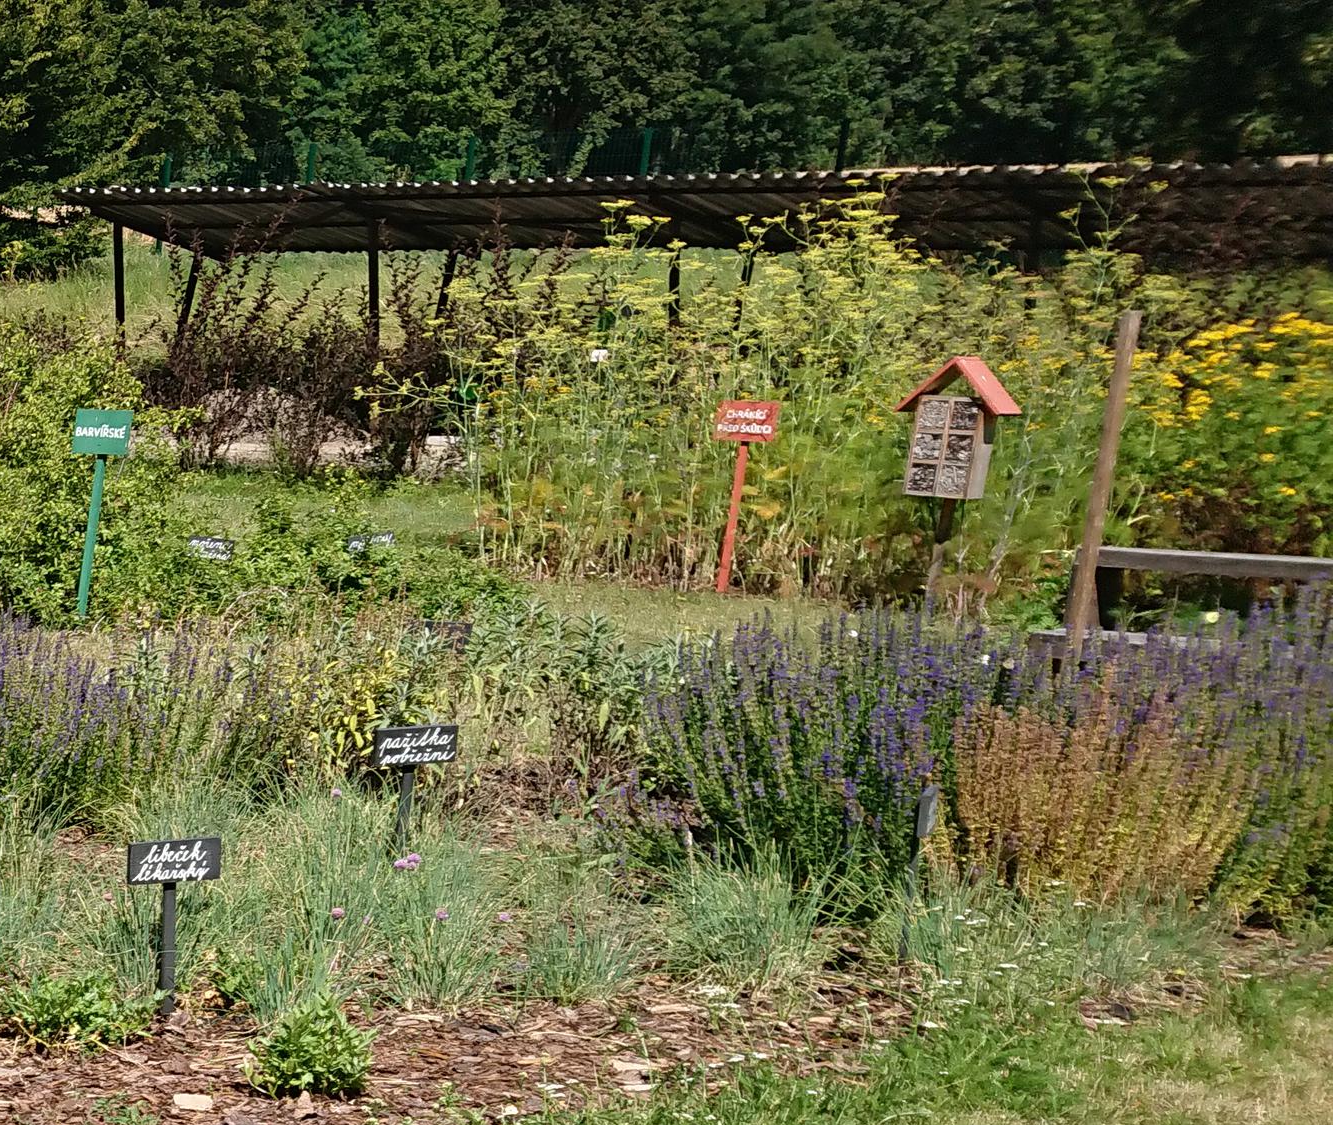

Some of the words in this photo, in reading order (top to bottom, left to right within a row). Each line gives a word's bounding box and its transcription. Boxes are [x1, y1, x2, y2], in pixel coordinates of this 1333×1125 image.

[75, 424, 127, 438] BARVÍŘSKÉ
[379, 727, 454, 757] pažitka
[380, 748, 455, 767] pobřežní
[140, 840, 207, 864] libeček
[132, 861, 210, 881] lékařský
